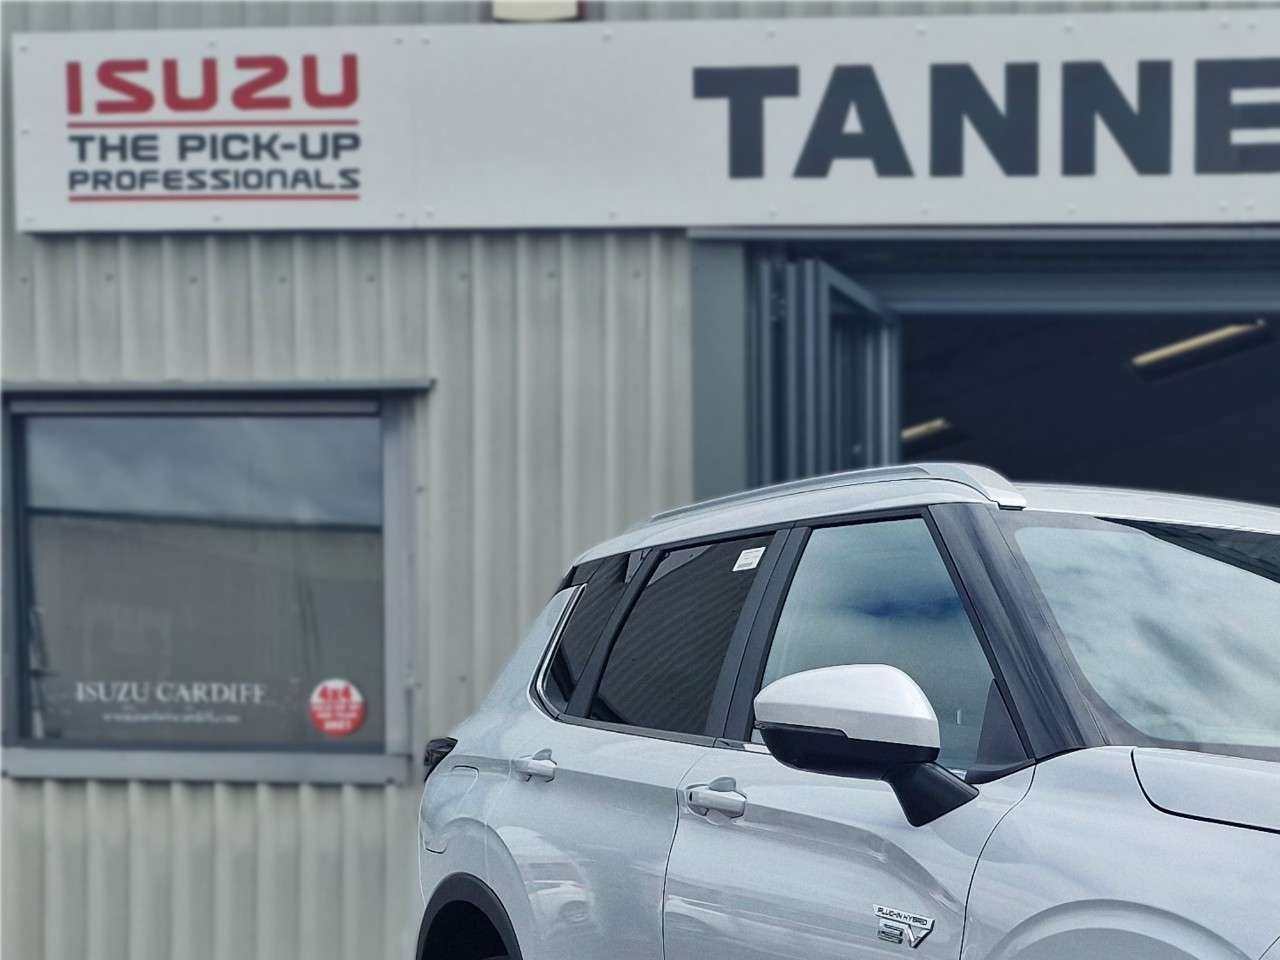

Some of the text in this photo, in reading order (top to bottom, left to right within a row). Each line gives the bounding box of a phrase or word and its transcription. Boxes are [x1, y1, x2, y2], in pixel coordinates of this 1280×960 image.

[66, 53, 360, 115] ISUZU
[69, 132, 361, 163] THE PICK-UP
[68, 167, 361, 192] PROFESSIONALS
[76, 682, 268, 703] ISUZU CARDIFF
